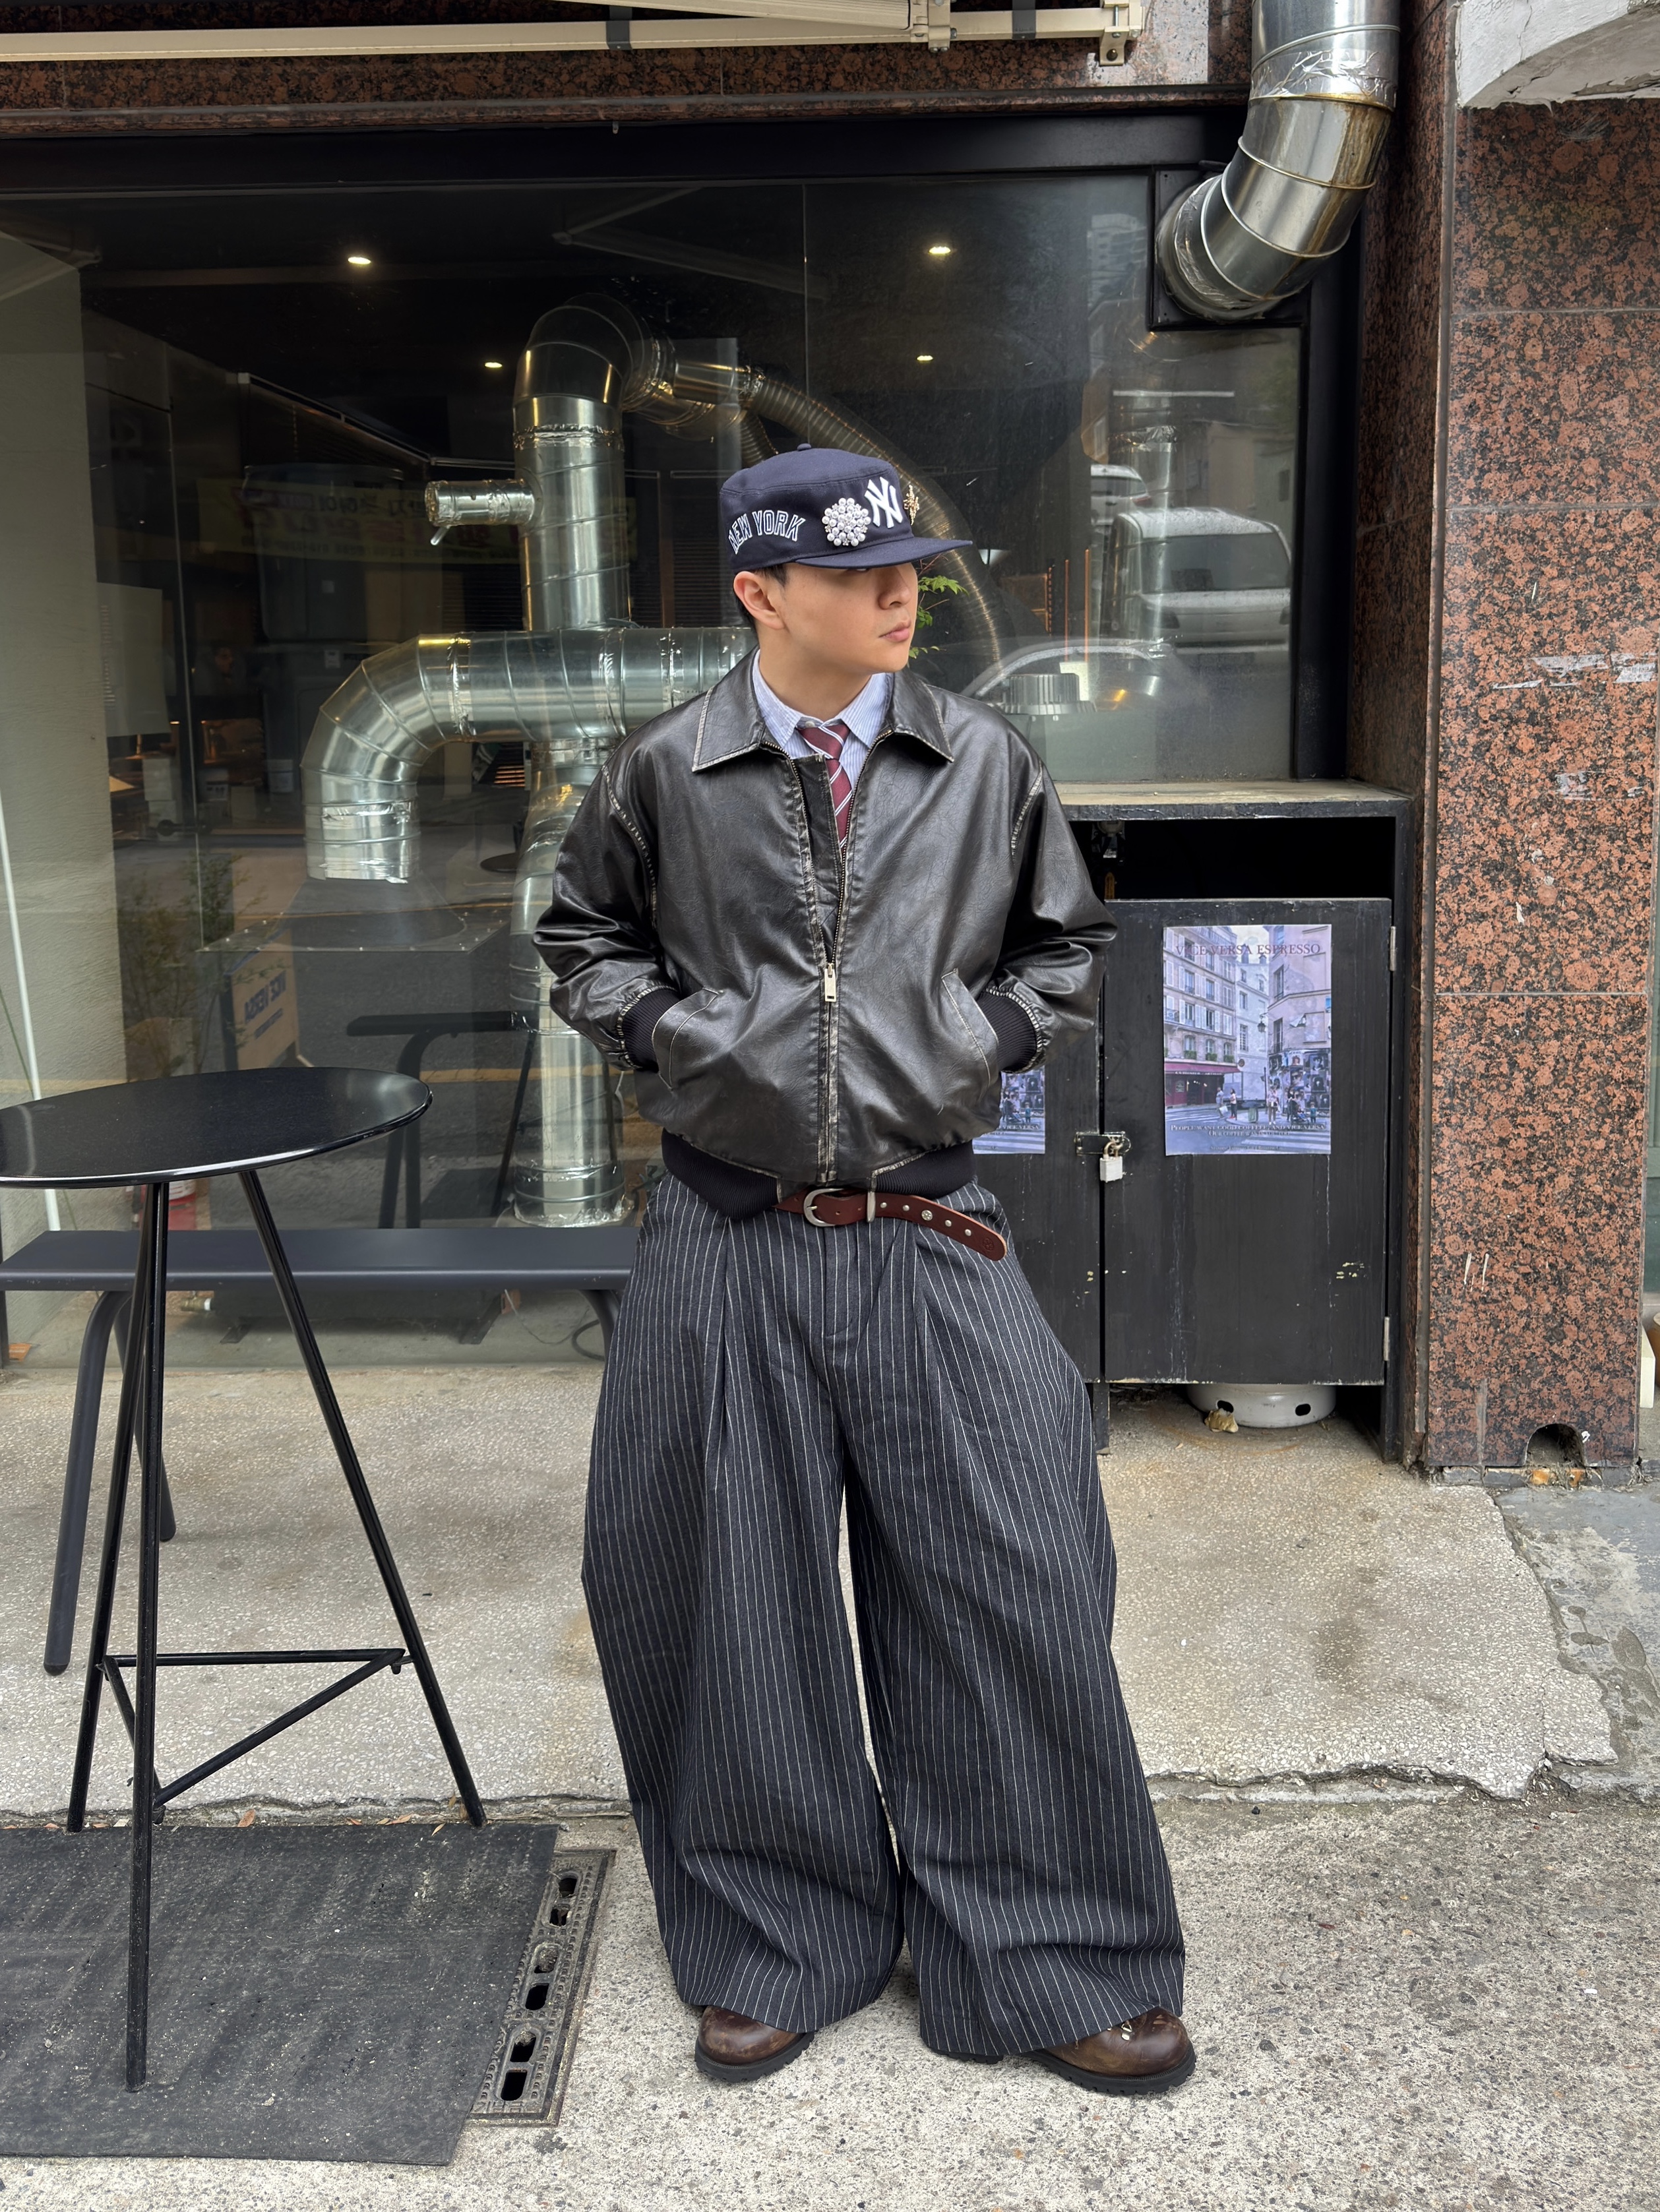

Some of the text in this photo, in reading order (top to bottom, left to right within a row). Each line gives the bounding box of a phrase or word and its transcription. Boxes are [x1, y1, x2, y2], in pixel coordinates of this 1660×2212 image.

[864, 476, 903, 528] NY
[728, 509, 806, 555] NEW YORK
[1211, 944, 1252, 955] VERSA
[1257, 943, 1321, 955] ESPRESSO
